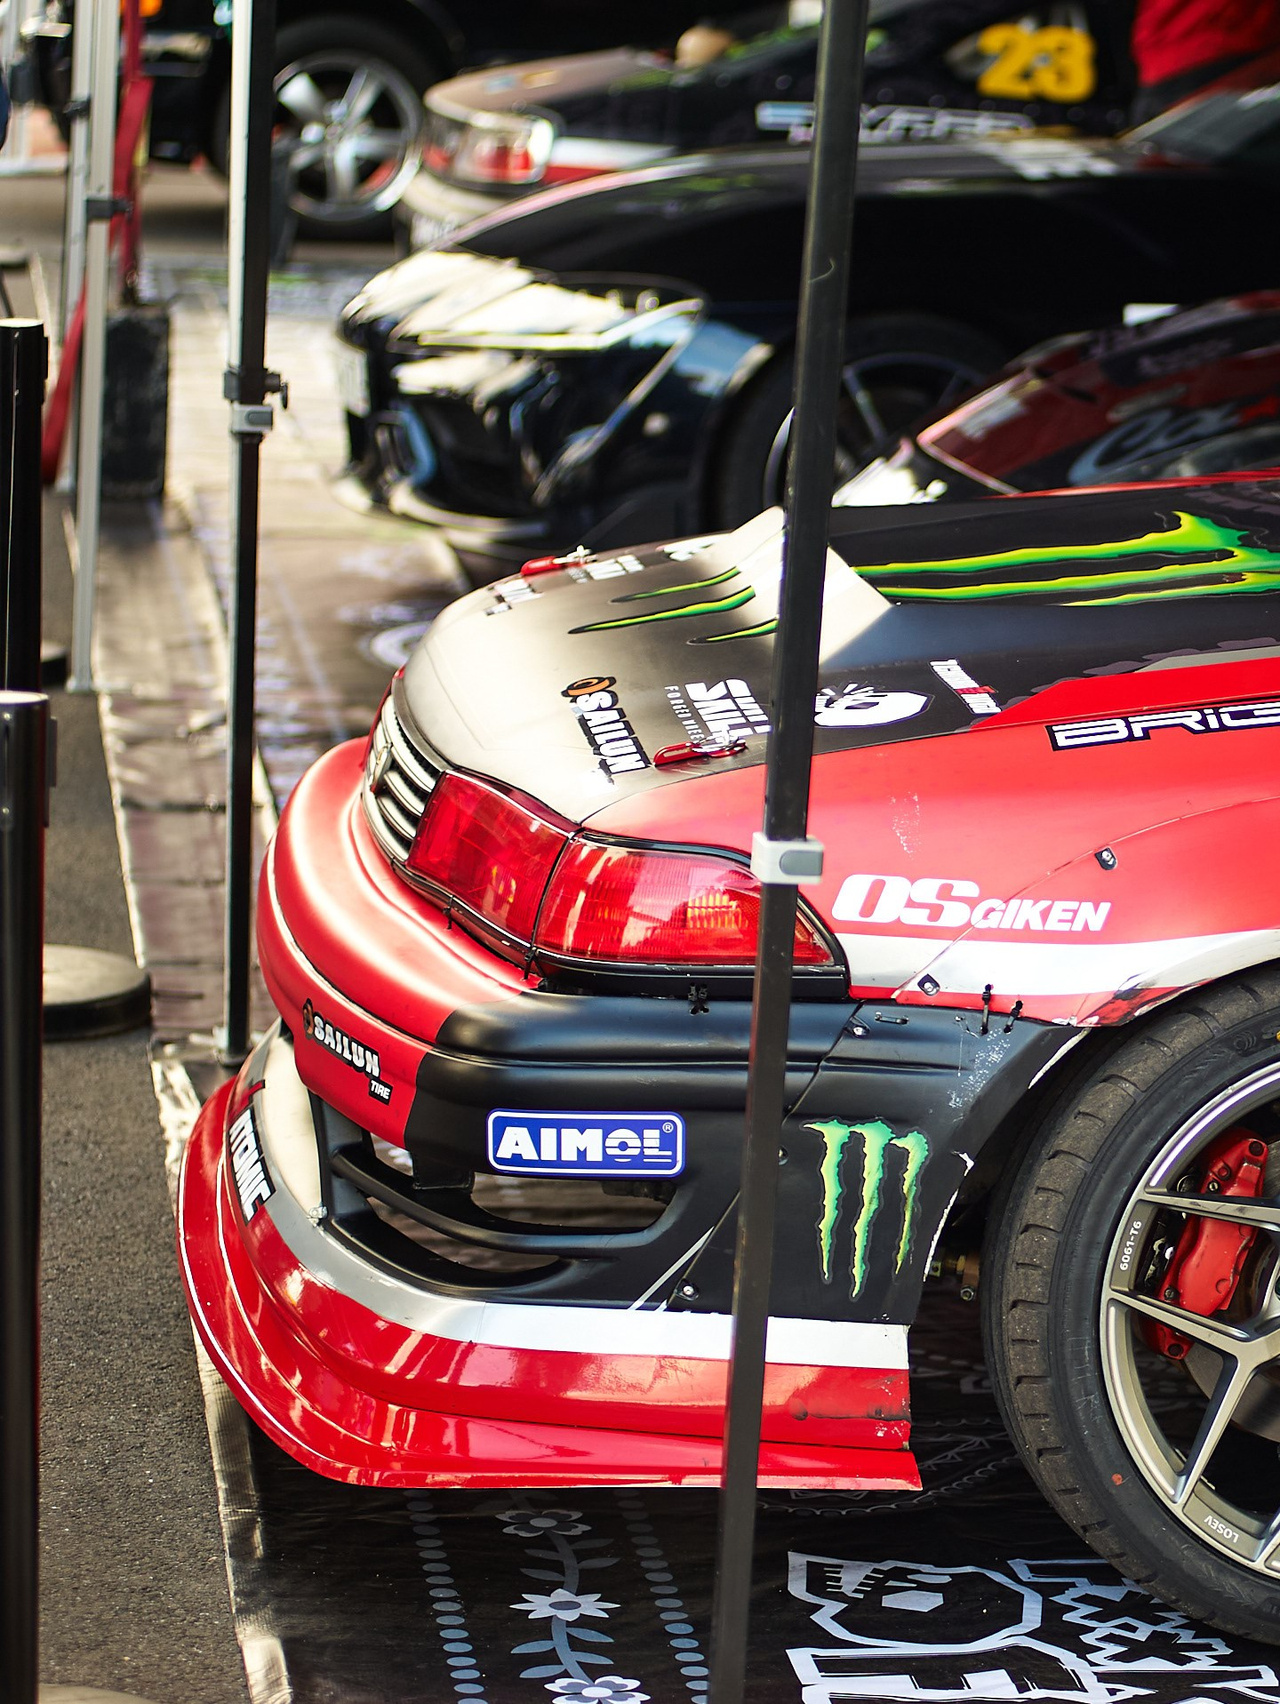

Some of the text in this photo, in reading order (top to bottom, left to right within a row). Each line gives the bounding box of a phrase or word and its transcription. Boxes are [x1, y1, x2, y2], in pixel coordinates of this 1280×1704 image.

[977, 23, 1095, 103] 23
[576, 690, 647, 774] SAILUN
[313, 1014, 380, 1078] SAILUN
[370, 1079, 391, 1100] TIRE
[1120, 1220, 1142, 1271] 6061-T6
[1203, 1515, 1240, 1543] LOSEV
